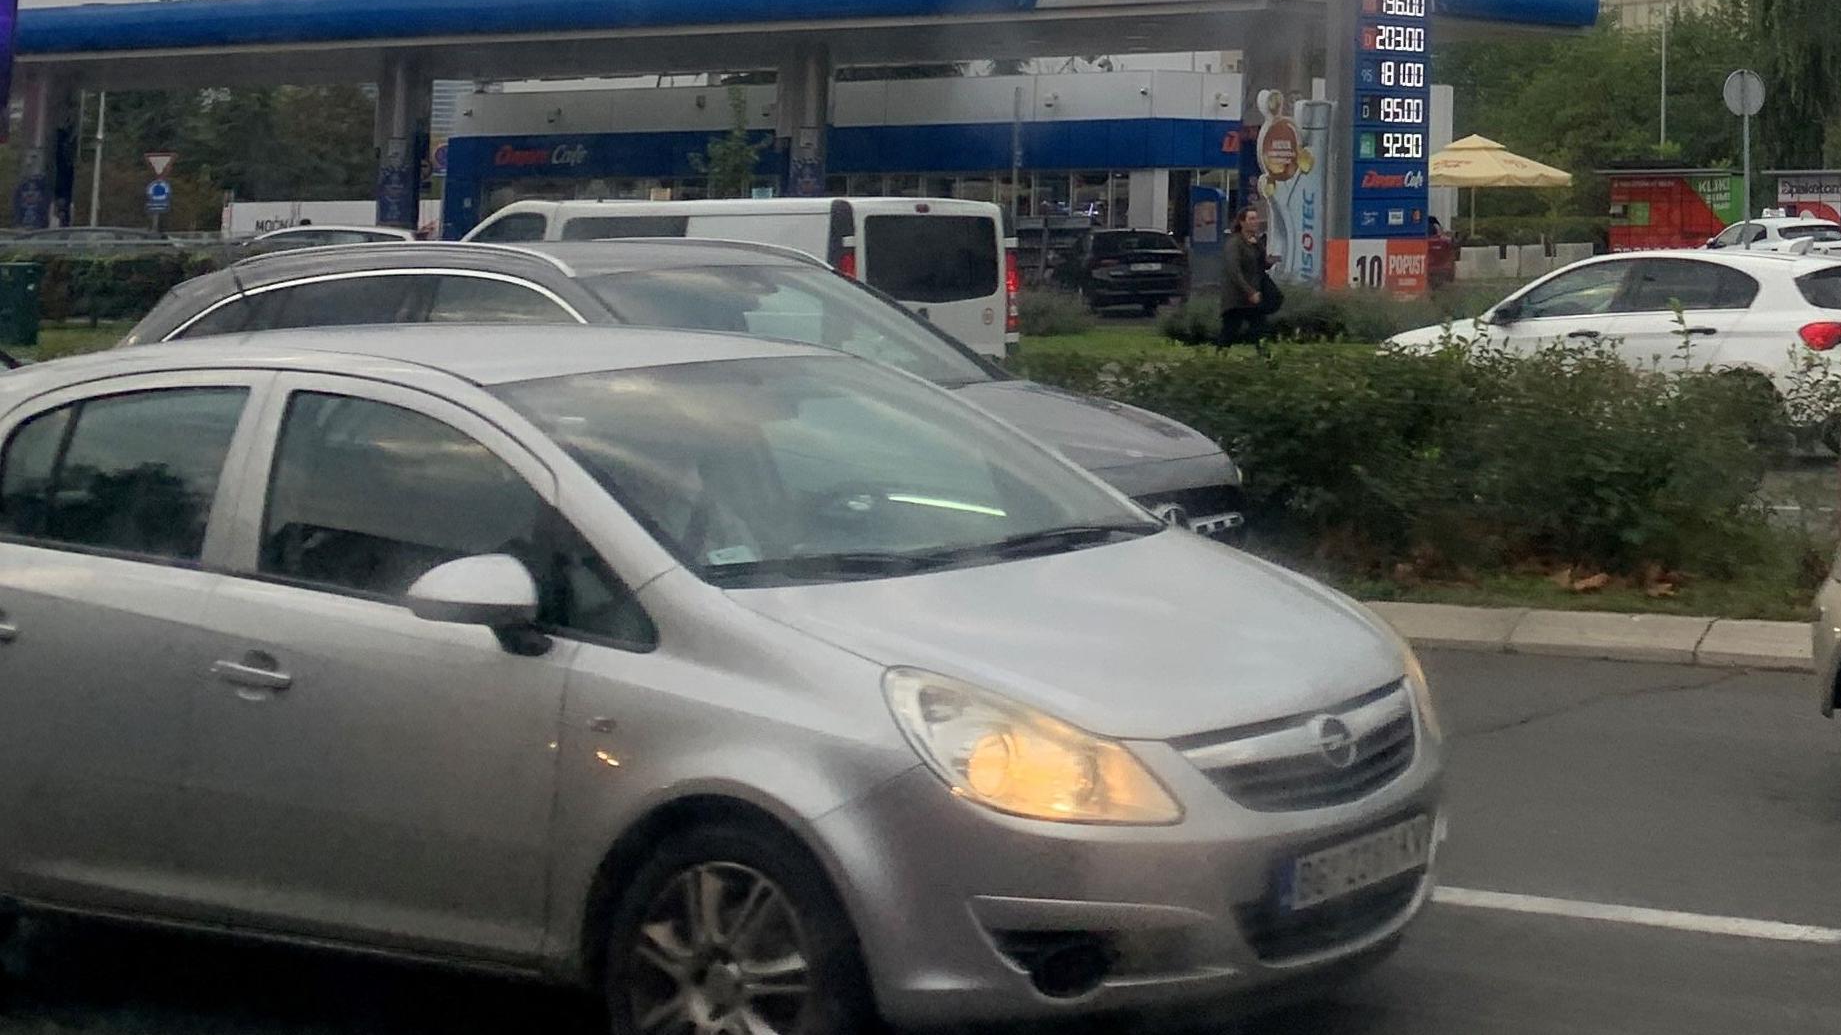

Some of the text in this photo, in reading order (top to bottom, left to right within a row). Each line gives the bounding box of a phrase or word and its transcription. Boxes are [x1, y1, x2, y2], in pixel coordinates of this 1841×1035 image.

[1376, 25, 1424, 52] 203.00
[1380, 97, 1423, 123] 195.00
[1383, 133, 1422, 158] 92.90
[1388, 255, 1426, 276] POPUST
